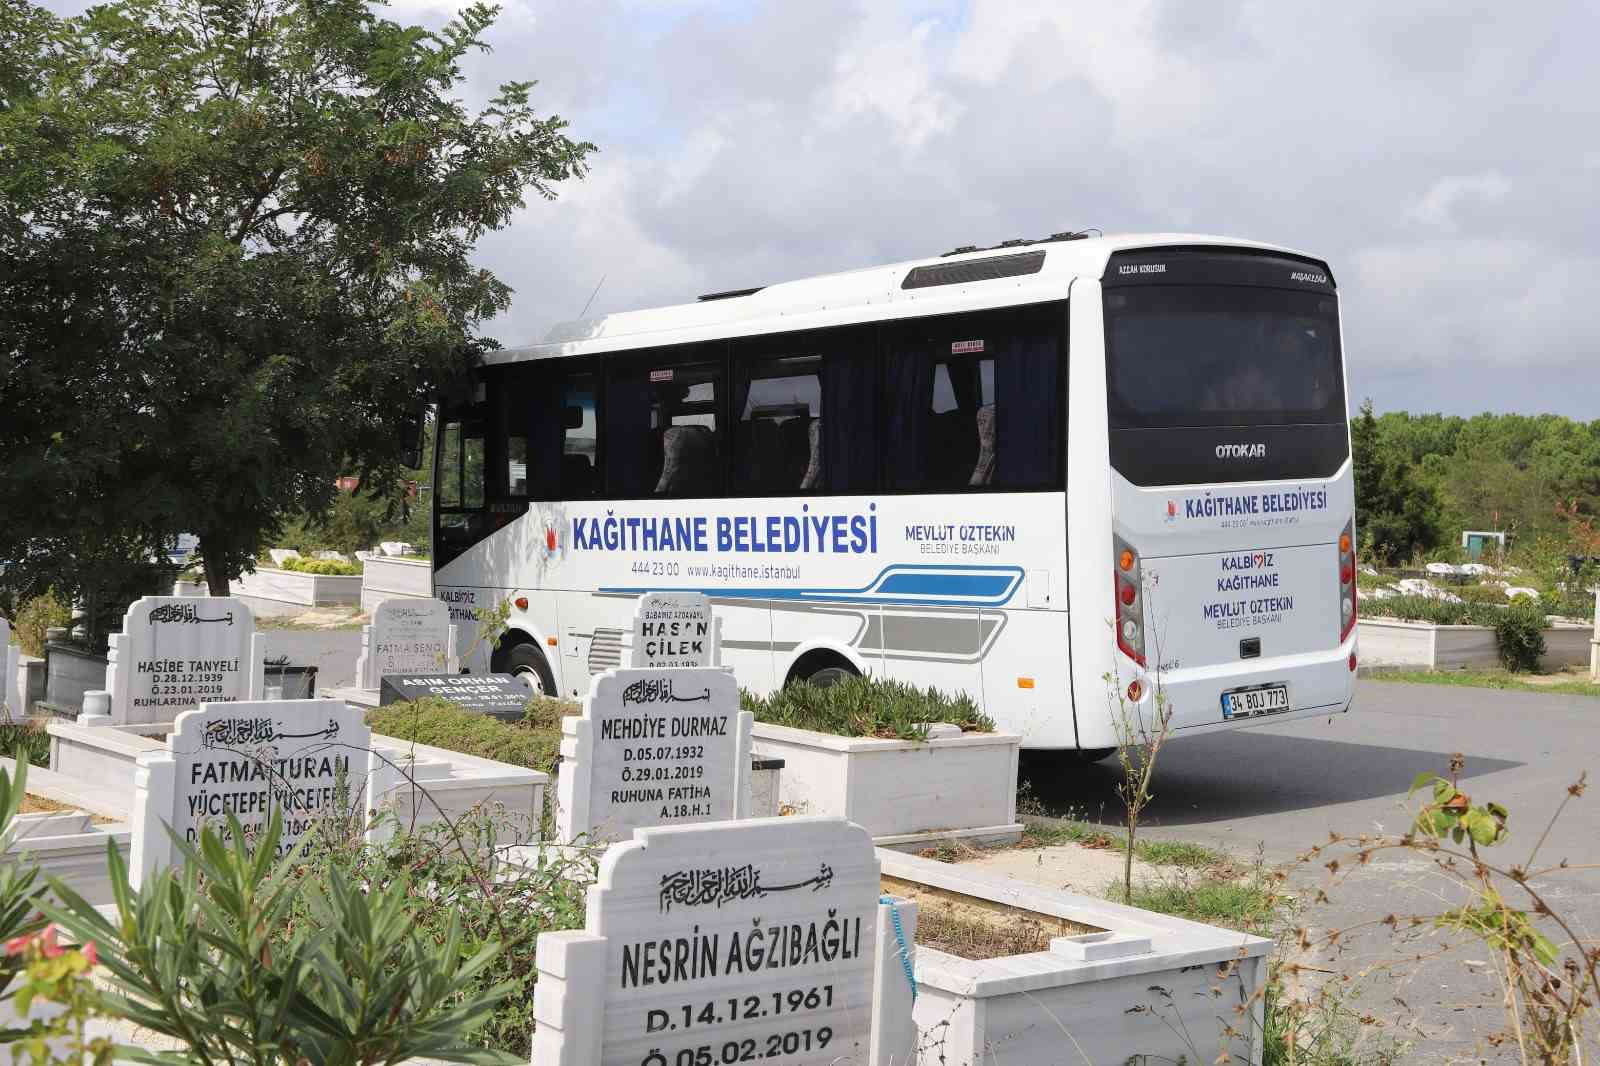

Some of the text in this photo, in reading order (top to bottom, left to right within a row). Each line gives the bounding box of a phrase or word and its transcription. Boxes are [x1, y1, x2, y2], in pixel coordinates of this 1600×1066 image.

[1215, 443, 1266, 459] OTOKAR
[1185, 485, 1328, 519] KAĞITHANE BELEDİYESİ
[572, 502, 878, 554] KAĞITHANE BELEDİYESİ
[631, 561, 650, 575] 444
[652, 561, 664, 576] 23
[666, 562, 680, 577] 00
[1217, 573, 1279, 592] KAĞITHANE
[646, 638, 703, 658] ÇİLEK
[137, 657, 240, 673] HASİBE TANYELİ
[152, 673, 223, 683] D.28.12.1939
[447, 677, 510, 686] ORHAN
[151, 684, 223, 695] Ö.23.01.2019
[133, 697, 197, 707] RUHLARINA
[1231, 695, 1243, 711] 34
[1267, 689, 1286, 707] 773
[601, 713, 728, 740] MEHDİYE DURMAZ
[623, 745, 705, 762] D.05.07.1932
[191, 761, 266, 785] FATMA
[621, 766, 704, 782] Ö.29.01.2019
[187, 790, 267, 817] YÜCETEPE
[611, 784, 712, 804] RUHUNA FATİHA
[621, 908, 861, 989] NESRİN AĞZIBAĞLI
[646, 985, 834, 1033] D.14.12.1961
[641, 1026, 834, 1066] Ö05.02.2019
